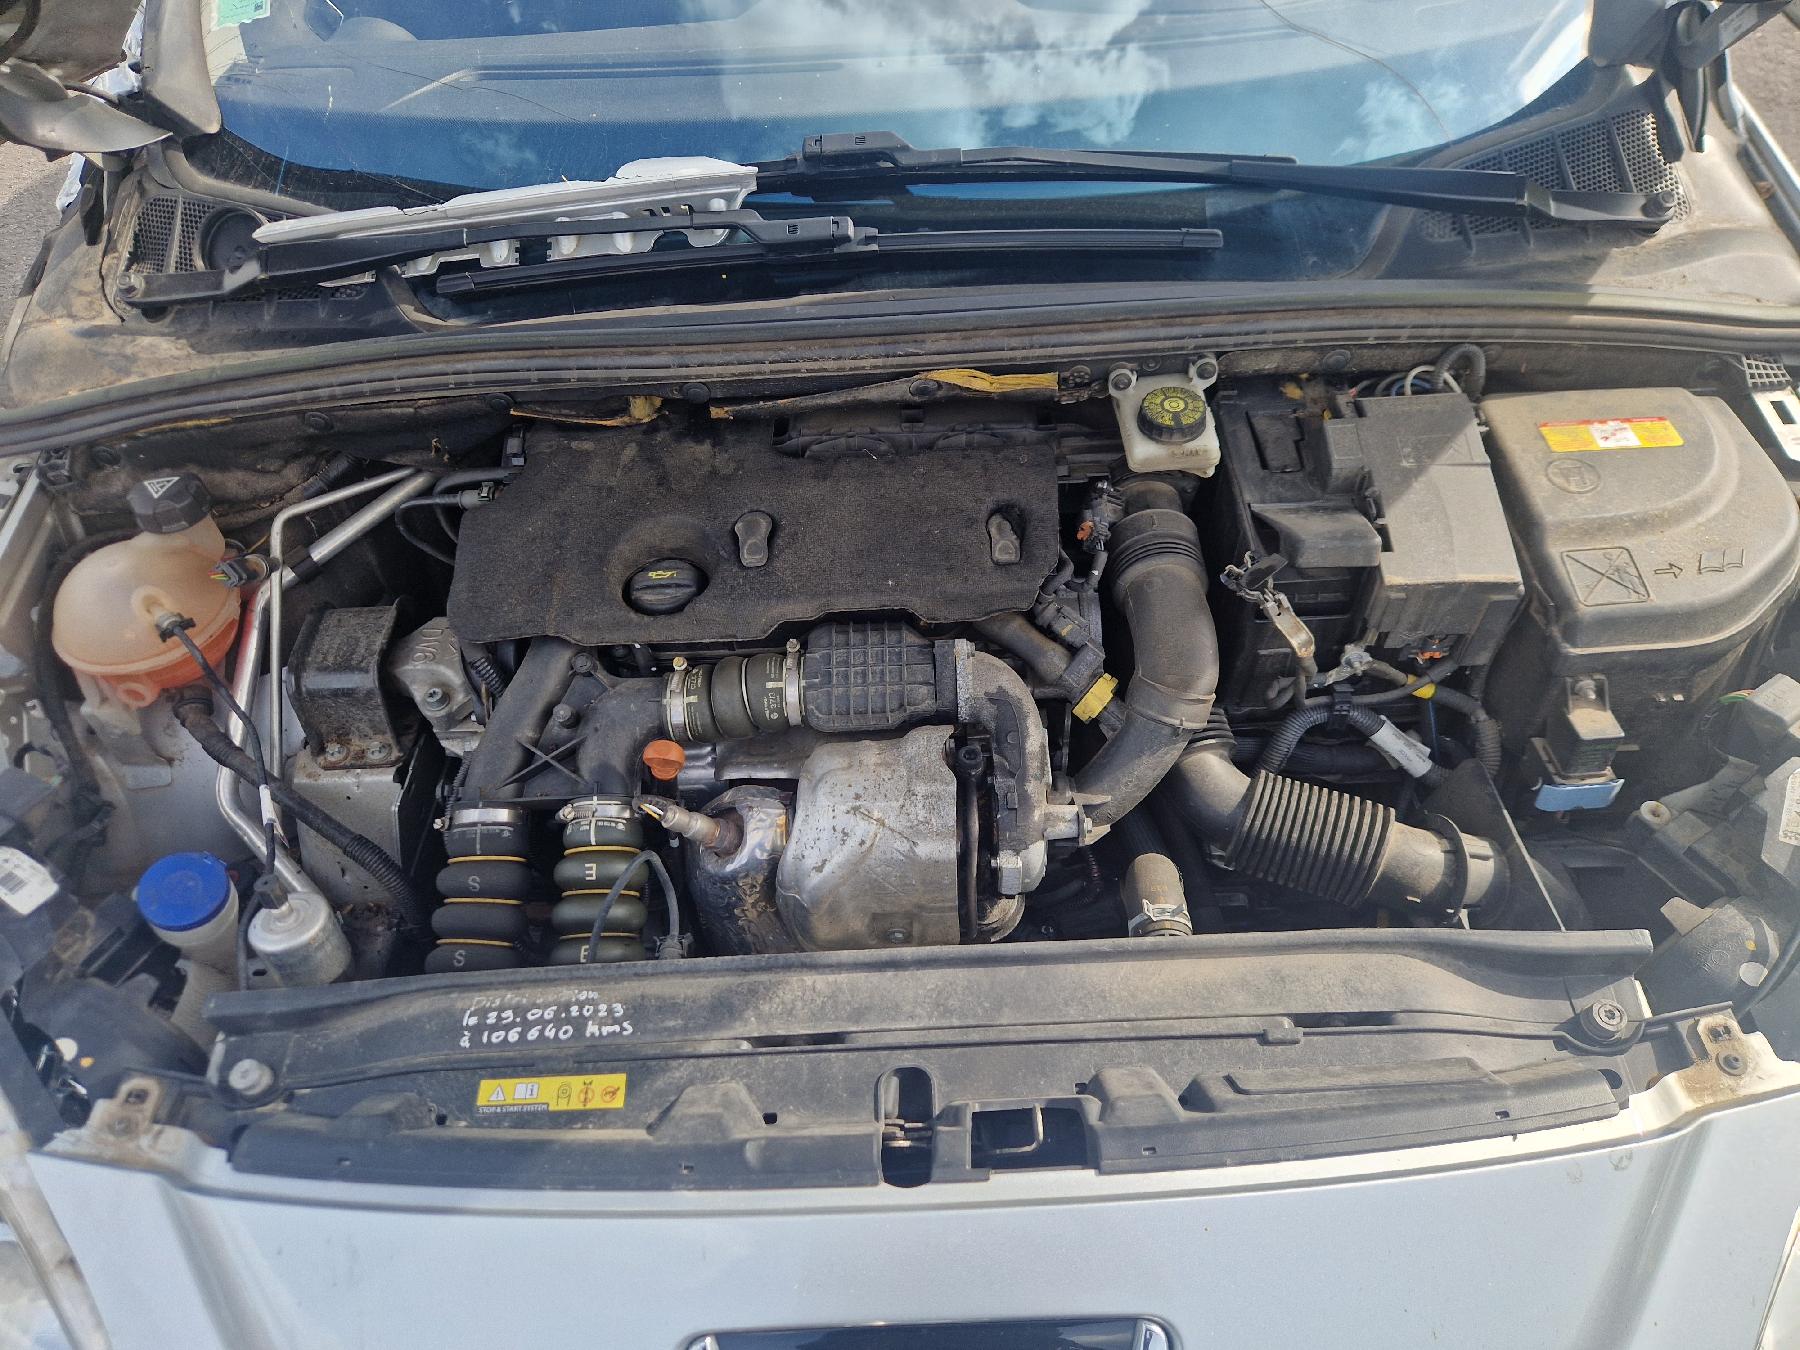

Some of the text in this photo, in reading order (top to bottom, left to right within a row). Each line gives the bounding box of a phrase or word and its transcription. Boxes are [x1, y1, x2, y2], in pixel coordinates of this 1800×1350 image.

[413, 628, 444, 664] DV6
[467, 875, 481, 892] S
[452, 949, 466, 967] S
